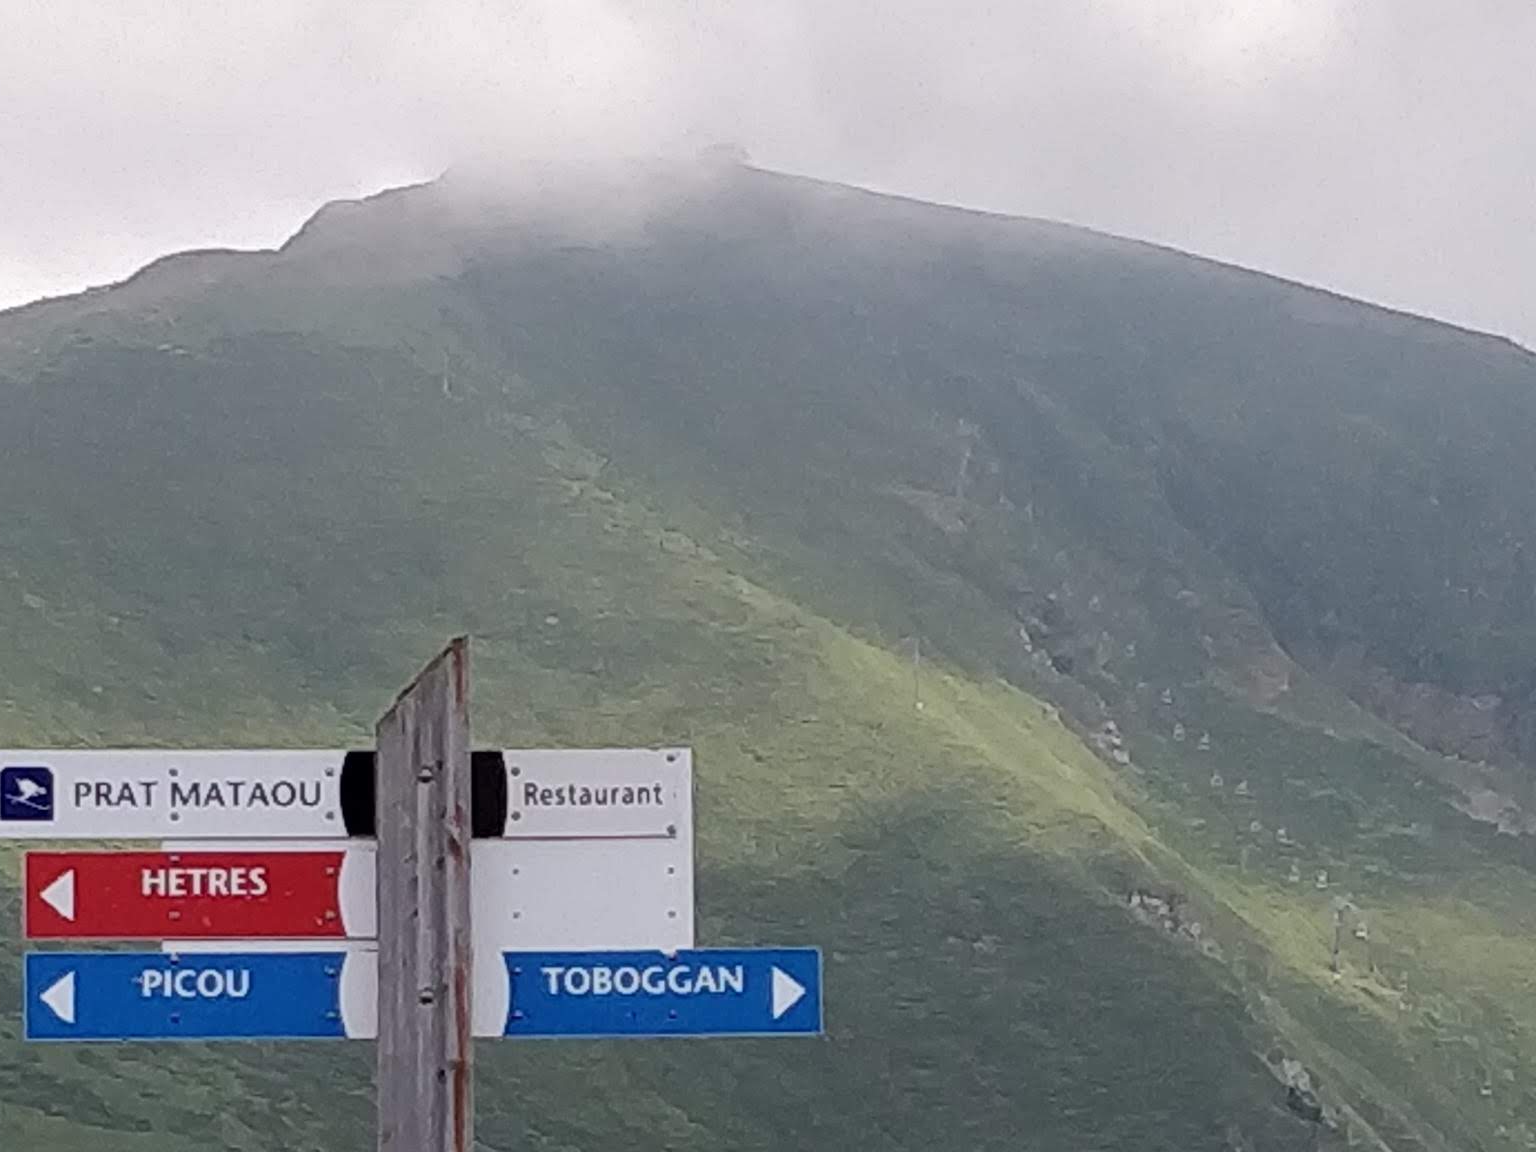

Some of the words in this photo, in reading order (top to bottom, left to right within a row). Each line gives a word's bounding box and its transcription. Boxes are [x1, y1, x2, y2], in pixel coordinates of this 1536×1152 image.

[74, 781, 158, 807] PRAT
[170, 781, 322, 807] MATAOU
[523, 782, 664, 806] Restaurant
[141, 867, 268, 896] HETRES
[142, 969, 251, 998] PICOU
[541, 966, 744, 994] TOBOGGAN
